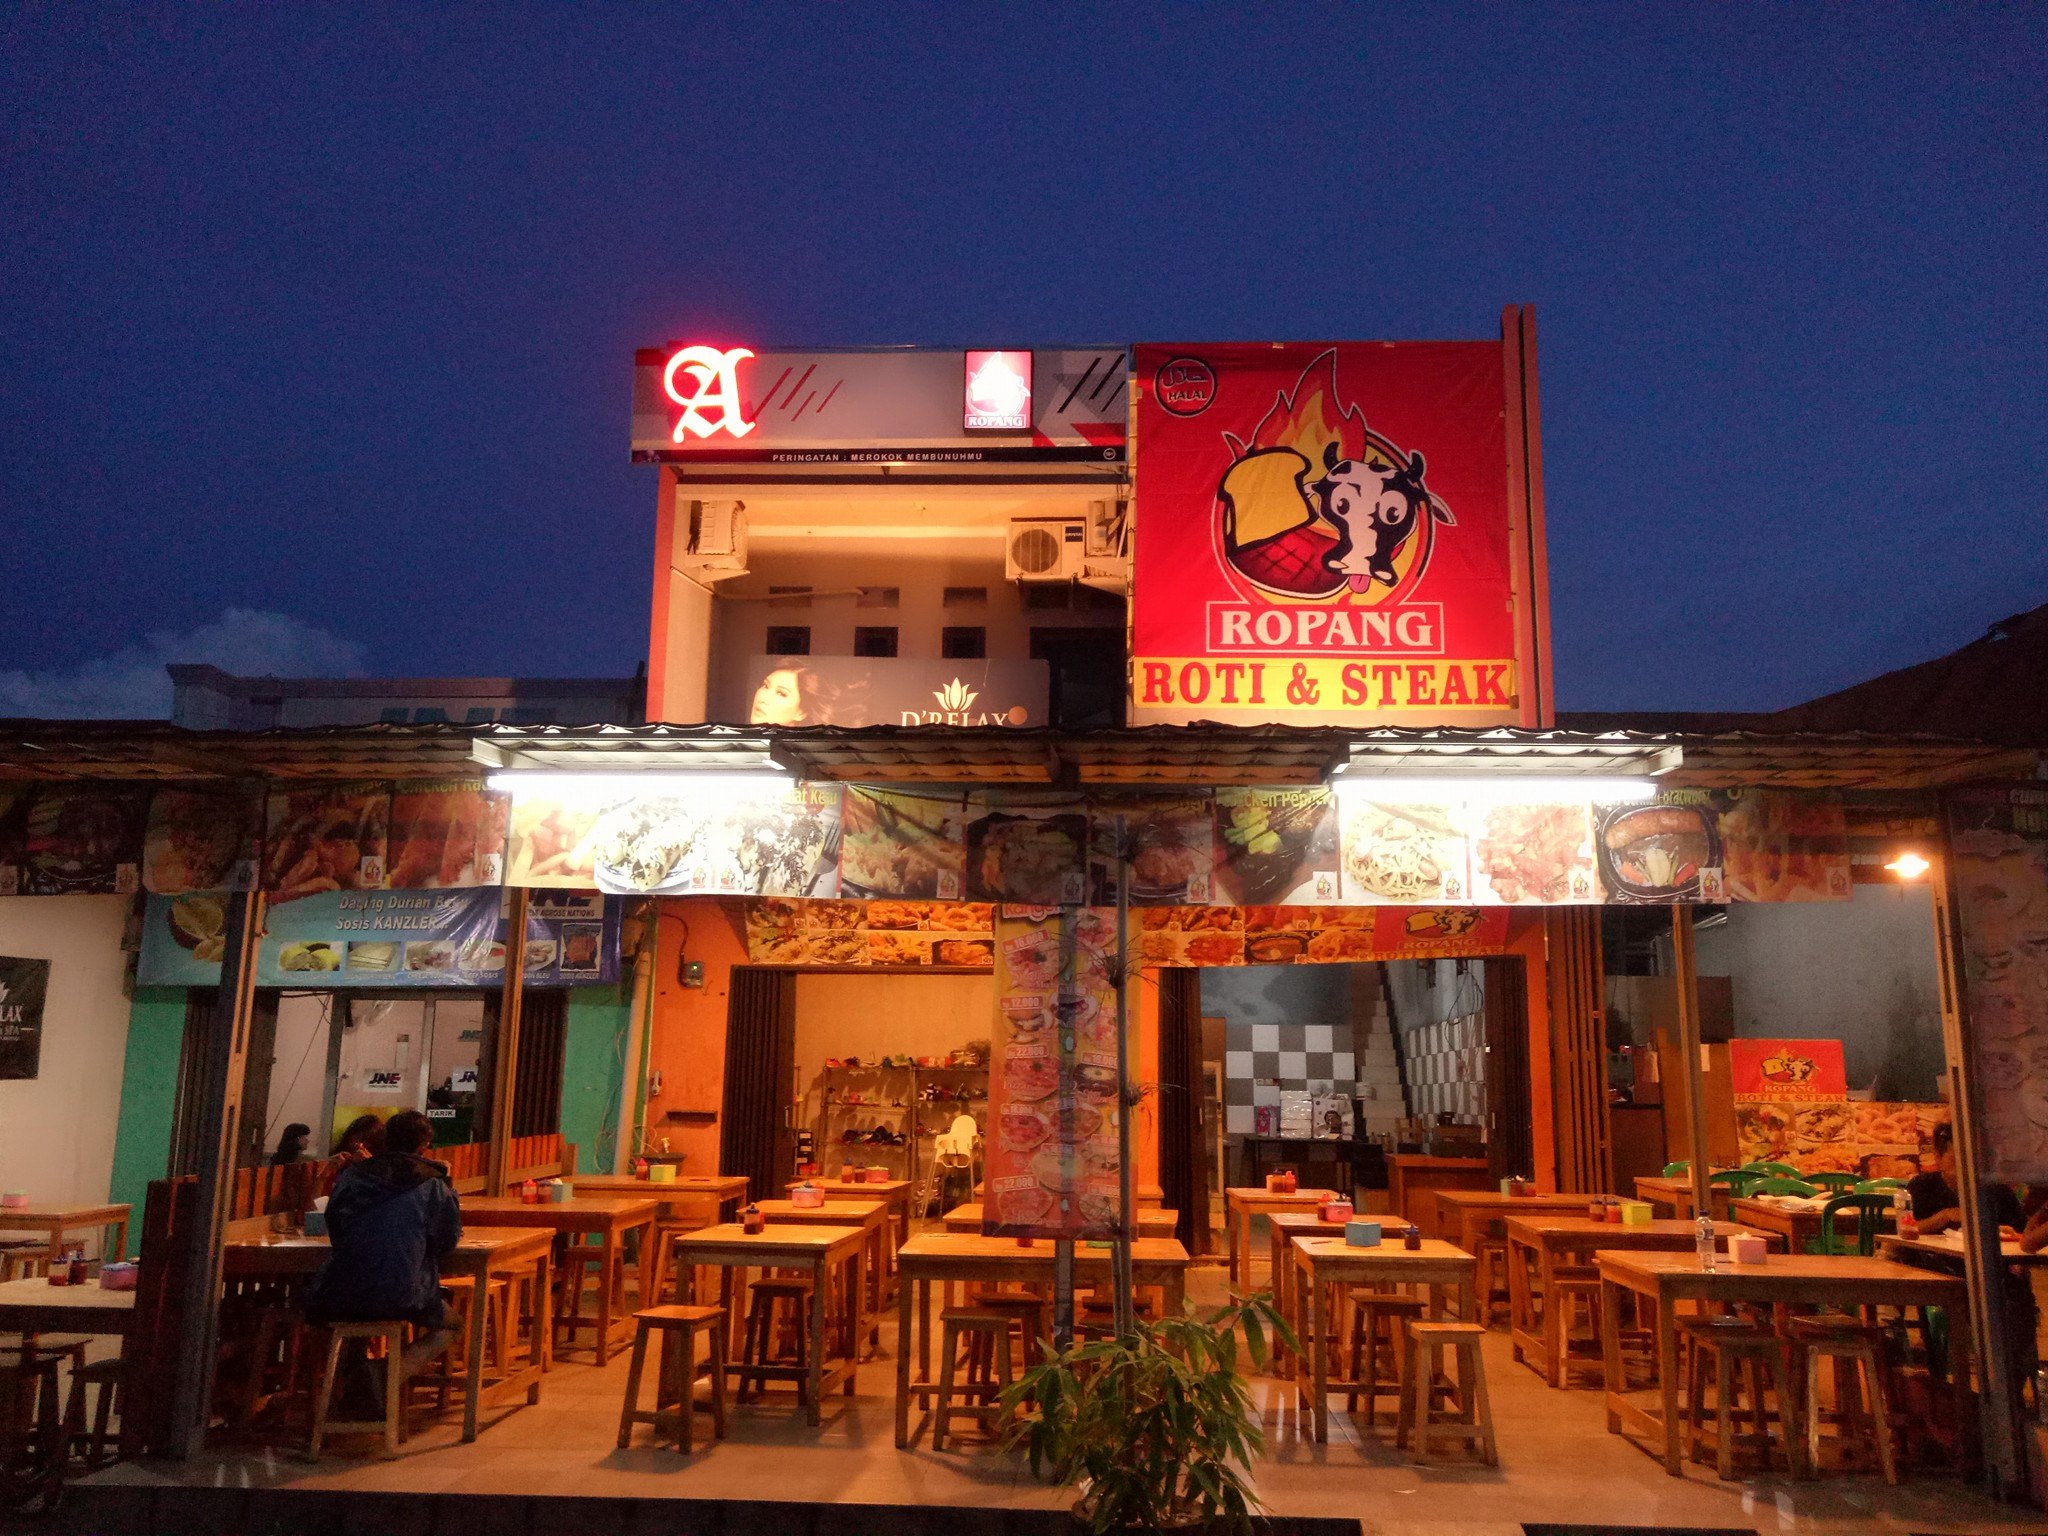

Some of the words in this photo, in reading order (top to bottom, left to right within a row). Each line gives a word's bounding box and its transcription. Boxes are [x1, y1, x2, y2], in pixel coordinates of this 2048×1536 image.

[663, 345, 756, 444] A
[1167, 391, 1207, 403] HALAL
[968, 415, 1023, 427] ROPANG
[772, 454, 839, 462] PERINGATAN
[850, 453, 903, 461] MEROKOK
[906, 452, 983, 461] MEMBUNUHMU
[1219, 609, 1433, 648] ROPANG
[1142, 661, 1266, 704] ROTI
[1286, 662, 1320, 705] &
[1341, 663, 1510, 706] STEAK
[388, 895, 430, 910] Durian
[336, 917, 370, 931] Sosis
[1403, 938, 1477, 949] ROPANG
[1374, 950, 1417, 959] ROTI
[369, 1072, 401, 1085] JNE
[457, 1070, 478, 1083] JN
[1765, 1085, 1817, 1093] ROPANG
[1738, 1094, 1773, 1102] ROTI
[1794, 1094, 1845, 1103] STEAK
